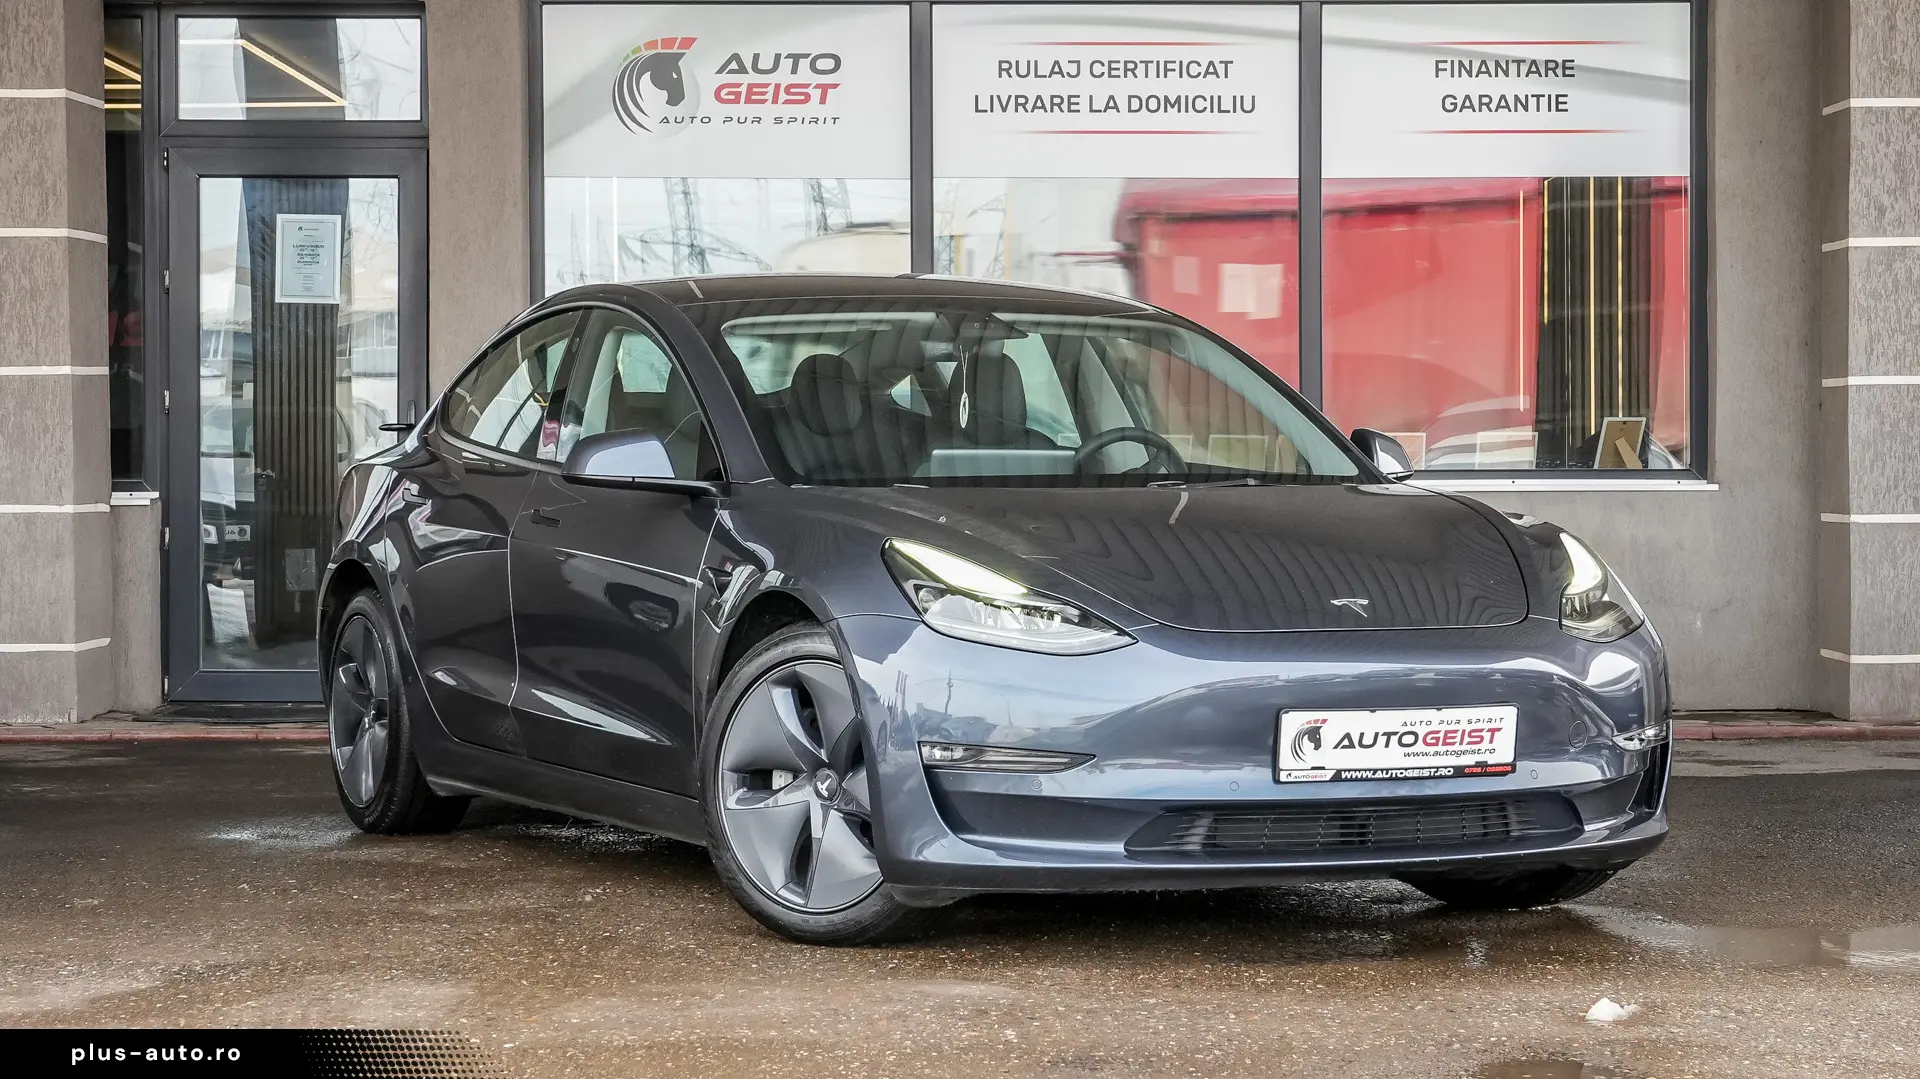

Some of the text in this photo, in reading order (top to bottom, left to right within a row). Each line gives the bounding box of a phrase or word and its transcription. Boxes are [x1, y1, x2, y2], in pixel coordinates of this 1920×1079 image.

[714, 52, 842, 76] AUTO
[998, 59, 1234, 79] RULAJ CERTIFICAT
[1435, 59, 1576, 78] FINANTARE
[713, 82, 841, 105] GEIST
[1441, 93, 1569, 113] GARANTIE
[974, 94, 1256, 114] LIVRARE LA DOMICILIU
[658, 115, 841, 125] AUTO PUR SPIRIT
[1403, 747, 1496, 759] www.autogeist.ro
[1341, 767, 1454, 779] WWW.AUTOGEIST.RO
